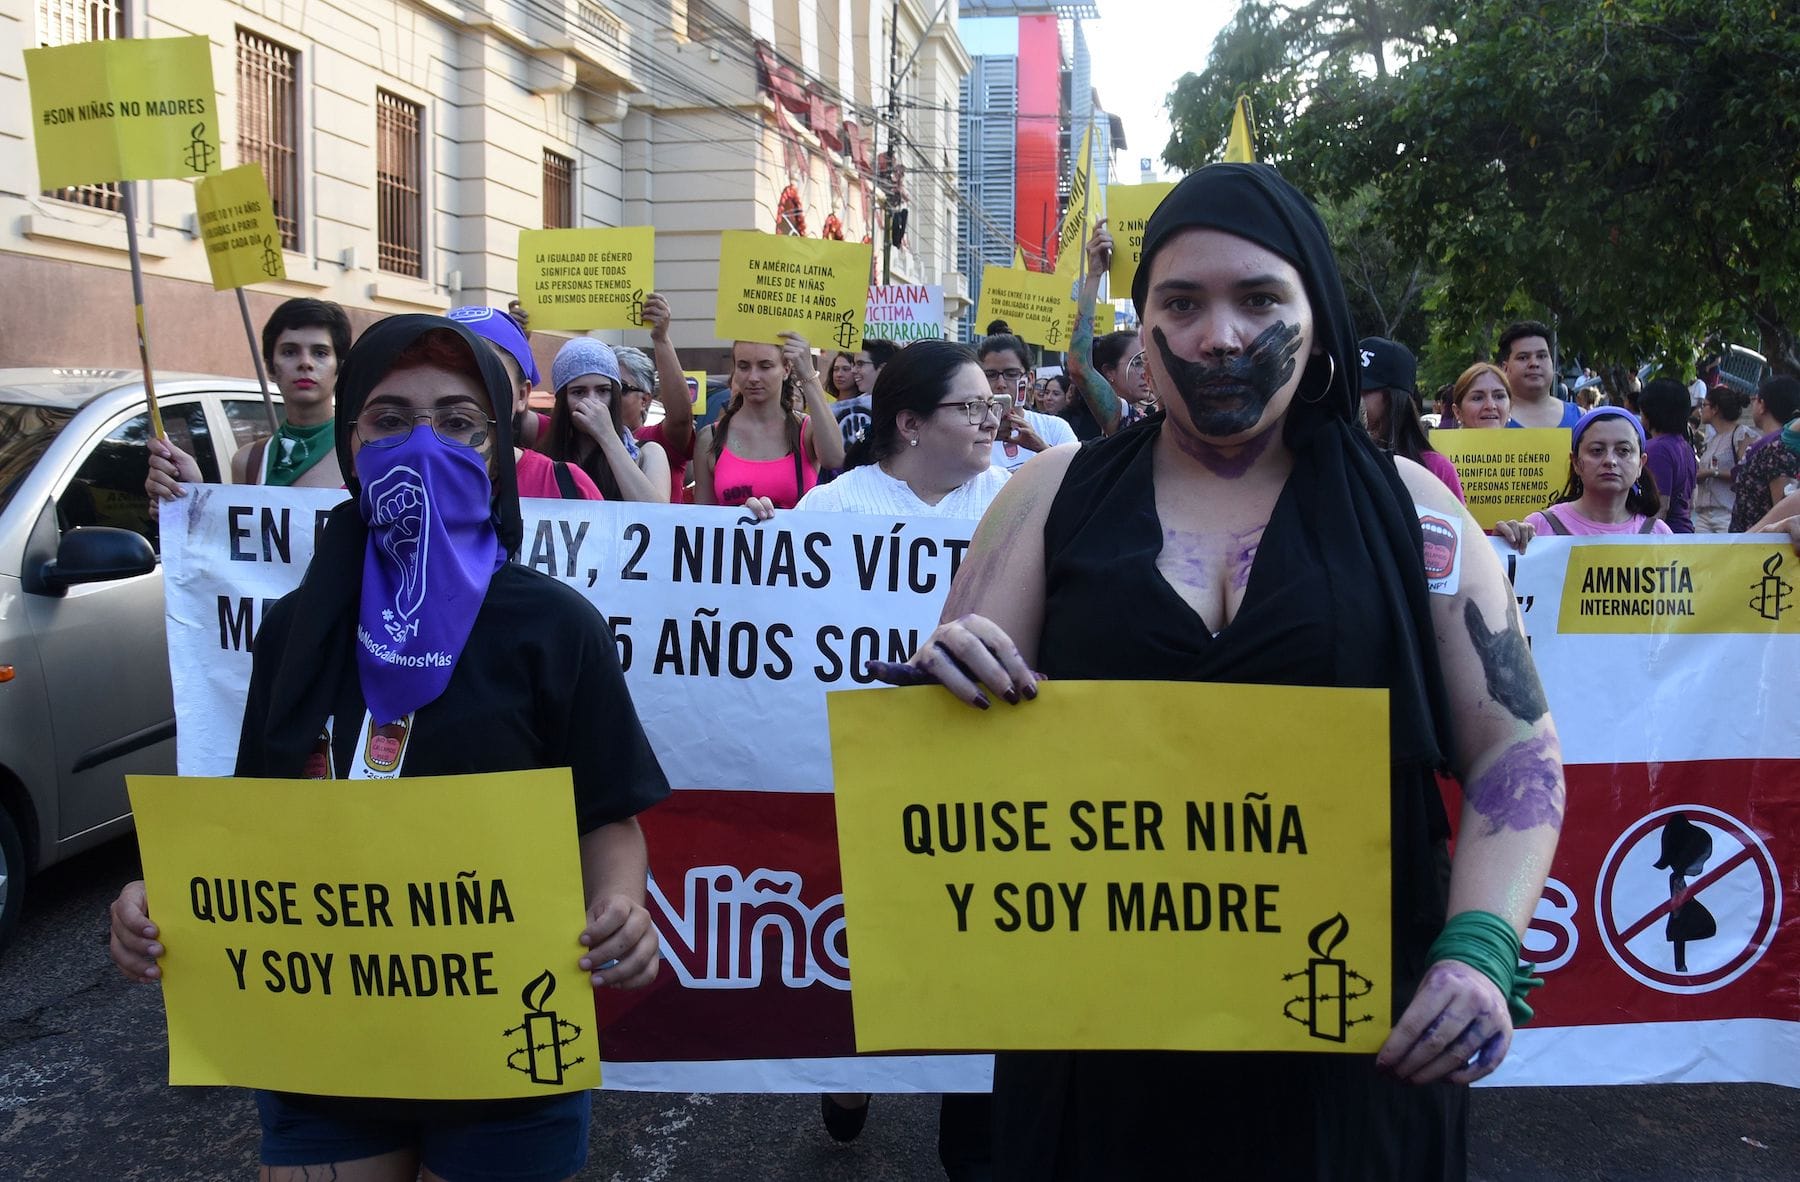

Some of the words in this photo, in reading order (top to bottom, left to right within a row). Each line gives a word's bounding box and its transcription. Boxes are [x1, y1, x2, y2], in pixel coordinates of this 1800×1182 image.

[44, 107, 75, 125] #SON
[78, 101, 115, 121] NIÑAS
[120, 101, 140, 117] NO
[146, 98, 205, 117] MADRES
[228, 208, 234, 217] Y
[234, 205, 243, 216] 14
[244, 201, 261, 214] AÑOS
[232, 222, 237, 232] A
[1119, 221, 1124, 231] 2
[231, 238, 248, 249] CADA
[536, 253, 546, 263] LA
[547, 252, 586, 262] IGUALDAD
[588, 252, 599, 262] DE
[601, 250, 633, 262] GÉNERO
[541, 266, 581, 277] SIGNIFICA
[584, 266, 599, 276] QUE
[601, 266, 626, 276] TODAS
[749, 259, 760, 270] EN
[762, 259, 801, 274] AMÉRICA
[803, 265, 835, 279] LATINA,
[536, 281, 549, 291] LAS
[552, 280, 593, 290] PERSONAS
[595, 279, 631, 289] TENEMOS
[756, 275, 782, 287] MILES
[784, 278, 796, 288] DE
[798, 279, 825, 291] NIÑAS
[538, 294, 553, 304] LOS
[555, 294, 586, 304] MISMOS
[588, 293, 631, 303] DERECHOS
[743, 288, 783, 302] MENORES
[786, 292, 797, 303] DE
[801, 294, 810, 304] 14
[813, 295, 837, 307] AÑOS
[992, 288, 1007, 297] NIÑAS
[1007, 290, 1022, 299] ENTRE
[1024, 292, 1032, 300] 10
[1038, 295, 1045, 303] 14
[1046, 295, 1061, 305] AÑOS
[737, 302, 755, 313] SON
[757, 304, 804, 319] OBLIGADAS
[806, 310, 812, 320] A
[815, 311, 842, 323] PARIR
[991, 298, 1001, 306] SON
[1002, 299, 1029, 310] OBLIGADAS
[1035, 304, 1053, 313] PARIR
[991, 307, 999, 315] EN
[999, 308, 1024, 319] PARAGUAY
[1025, 312, 1040, 321] CADA
[1041, 313, 1052, 323] DÍA
[863, 322, 940, 340] PATRIARCADO
[1450, 454, 1460, 463] LA
[1462, 454, 1502, 464] IGUALDAD
[1505, 454, 1515, 463] DE
[1518, 452, 1550, 463] GÉNERO
[1456, 468, 1497, 477] SIGNIFICA
[1500, 468, 1516, 478] QUE
[1518, 467, 1544, 477] TODAS
[1467, 481, 1509, 491] PERSONAS
[1511, 481, 1548, 490] TENEMOS
[1469, 495, 1502, 505] MISMOS
[1504, 494, 1547, 504] DERECHOS
[228, 506, 291, 564] EN
[620, 523, 651, 581] 2
[672, 515, 832, 590] NIÑAS
[1581, 561, 1694, 594] AMNISTÍA
[1580, 599, 1695, 617] INTERNACIONAL
[653, 607, 793, 682] AÑOS
[813, 625, 918, 684] SON
[902, 800, 1051, 857] QUISE
[1069, 799, 1165, 852] SER
[1185, 791, 1309, 856] NIÑA
[189, 876, 303, 927] QUISE
[313, 882, 393, 928] SER
[407, 869, 515, 928] NIÑA
[945, 882, 975, 933] Y
[993, 882, 1088, 933] SOY
[1106, 882, 1282, 934] MADRE
[225, 948, 248, 991] Y
[261, 949, 334, 996] SOY
[349, 951, 499, 998] MADRE
